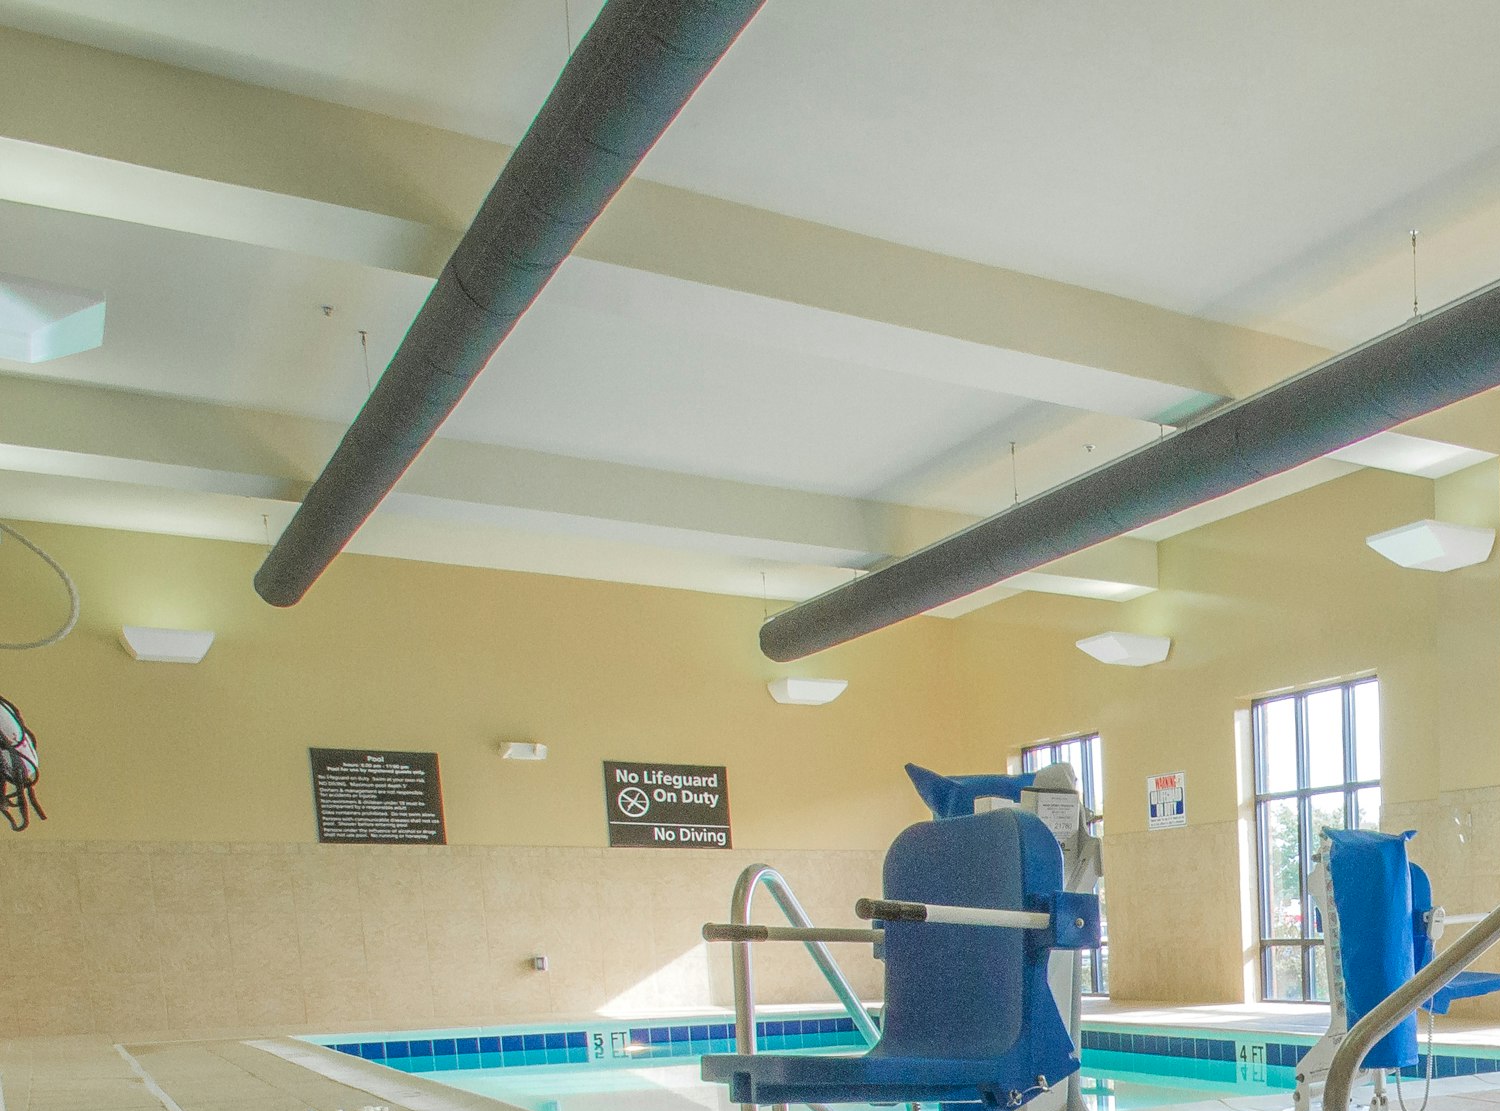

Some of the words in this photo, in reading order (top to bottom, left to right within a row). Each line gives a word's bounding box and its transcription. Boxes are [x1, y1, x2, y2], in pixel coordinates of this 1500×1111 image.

[367, 755, 384, 763] Pool
[616, 769, 639, 783] No
[643, 771, 718, 788] Lifeguard
[653, 789, 677, 803] On
[681, 790, 719, 808] Duty
[654, 827, 676, 841] No
[680, 828, 726, 846] Diving
[593, 1034, 604, 1047] 5
[611, 1032, 627, 1048] FT
[1240, 1045, 1247, 1062] 4
[1252, 1046, 1264, 1063] FT
